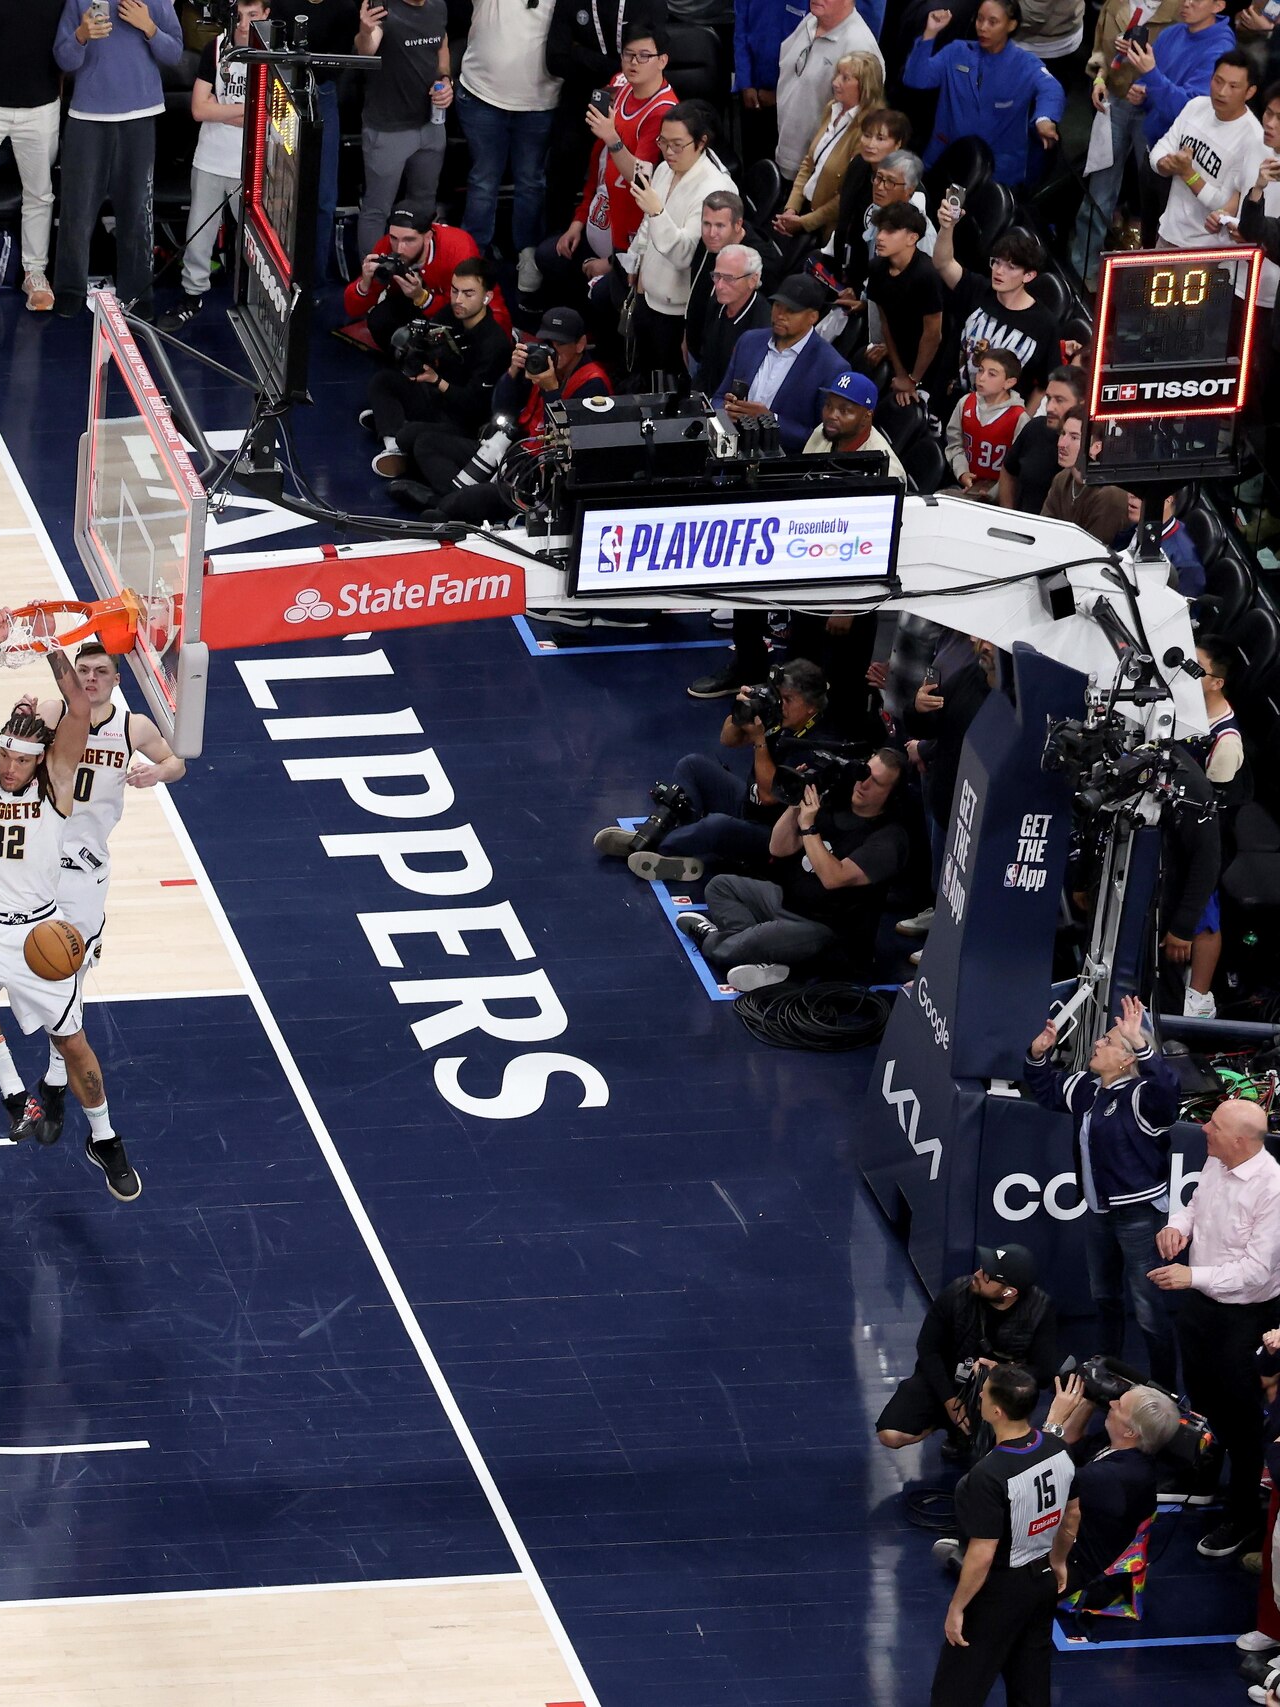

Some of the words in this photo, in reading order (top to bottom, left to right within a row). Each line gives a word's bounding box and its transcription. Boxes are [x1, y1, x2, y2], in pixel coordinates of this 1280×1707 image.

[404, 36, 441, 47] GIVENCHY
[1150, 270, 1207, 307] 0.0
[111, 312, 129, 337] Emirates
[135, 364, 154, 389] Emirates
[1139, 377, 1236, 400] TISSOT
[160, 417, 179, 442] Emirates
[978, 440, 1007, 471] 32
[185, 470, 205, 496] Emirates
[626, 517, 780, 573] PLAYOFFS
[788, 519, 837, 535] Presented
[837, 518, 850, 534] by
[786, 536, 873, 562] Google
[79, 748, 125, 769] GETS
[959, 779, 978, 831] GET
[1020, 813, 1053, 838] GET
[953, 817, 971, 873] THE
[1016, 839, 1048, 863] THE
[235, 633, 610, 1120] LIPPERS
[1016, 864, 1048, 892] App
[948, 865, 966, 925] App
[55, 920, 80, 957] Wilson
[918, 976, 949, 1051] Google
[1033, 1468, 1057, 1514] 15
[1031, 1514, 1059, 1532] Emirates
